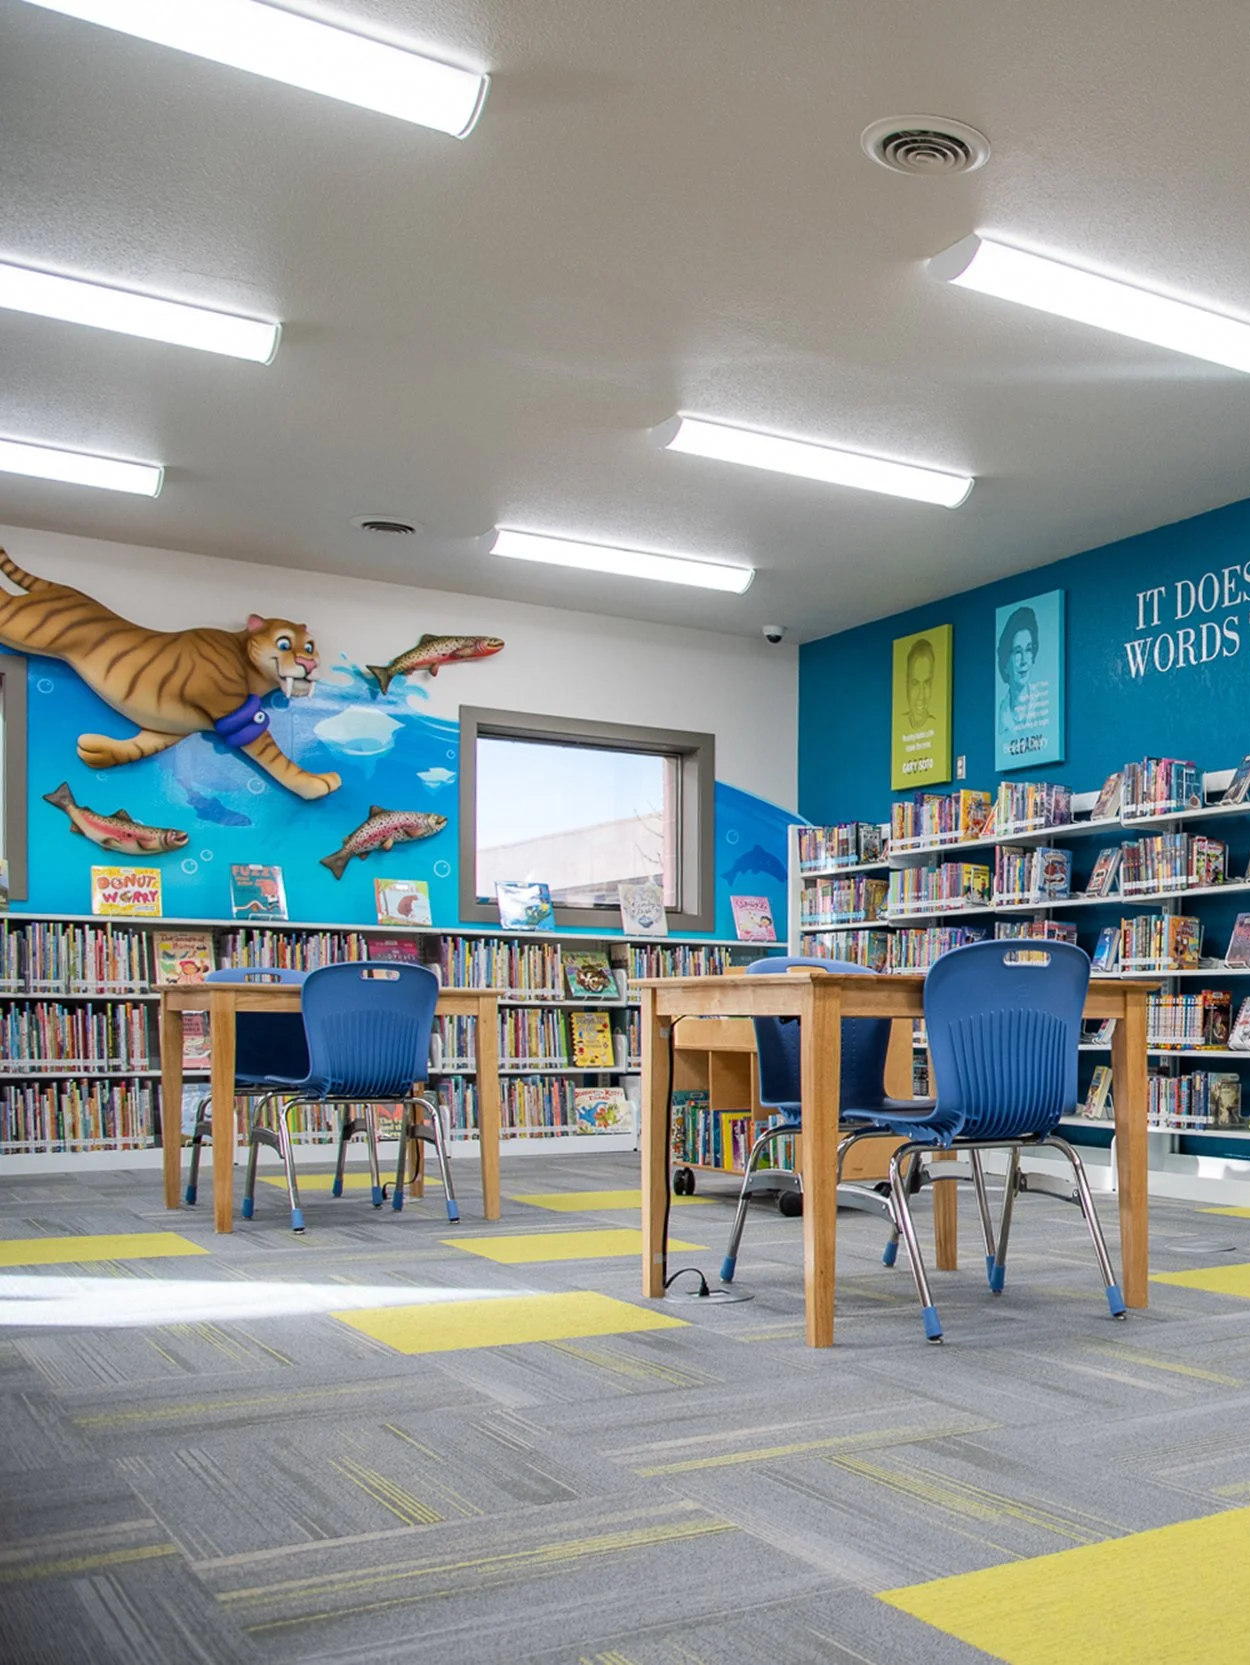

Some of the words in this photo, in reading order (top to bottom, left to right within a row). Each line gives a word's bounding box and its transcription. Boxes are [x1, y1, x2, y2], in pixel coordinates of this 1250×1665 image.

[1135, 586, 1166, 630] IT
[1124, 615, 1240, 679] WORDS
[97, 873, 157, 890] DONUT
[102, 889, 158, 904] WORRY
